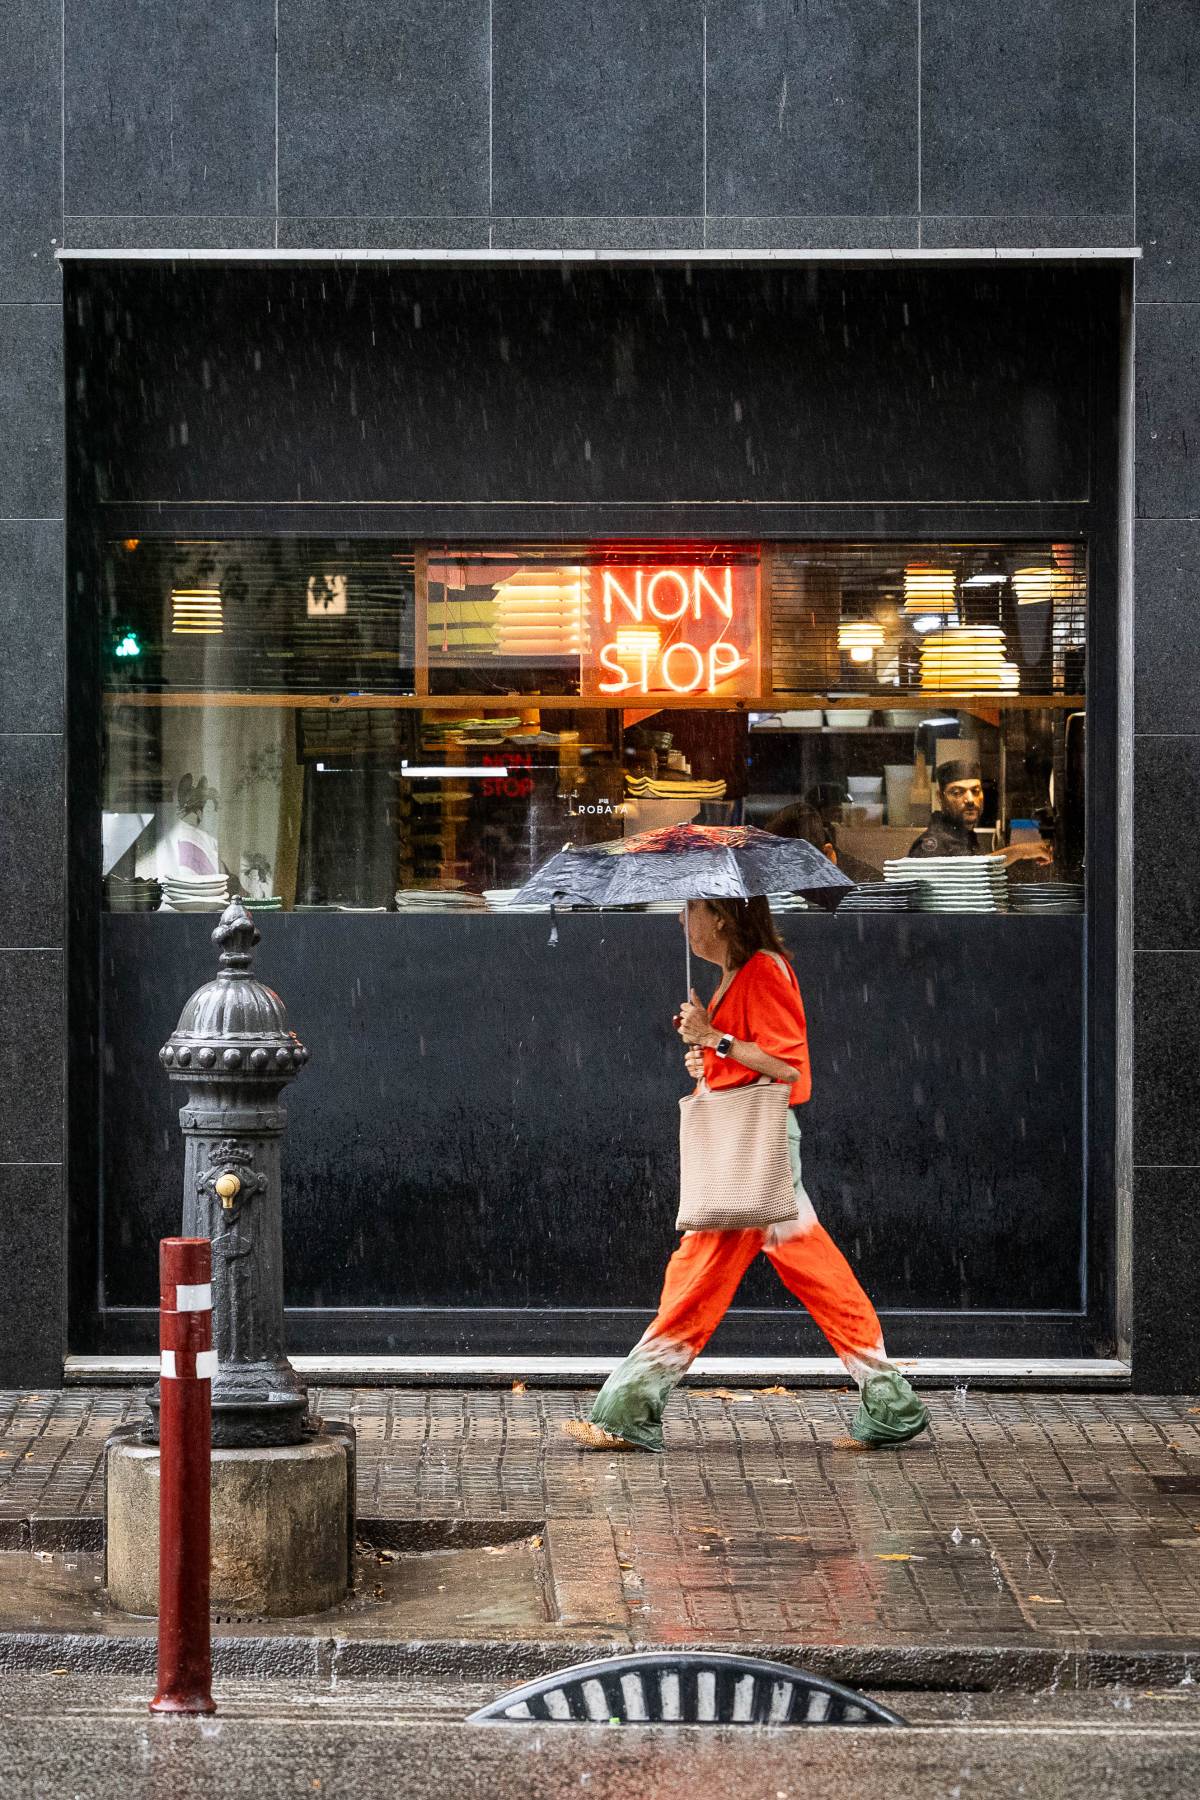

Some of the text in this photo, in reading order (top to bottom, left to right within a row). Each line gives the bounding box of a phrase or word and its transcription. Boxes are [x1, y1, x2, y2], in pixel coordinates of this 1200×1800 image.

[602, 568, 733, 623] NON
[599, 642, 750, 693] STOP
[480, 777, 534, 798] STOP
[578, 805, 628, 814] ROBATA
